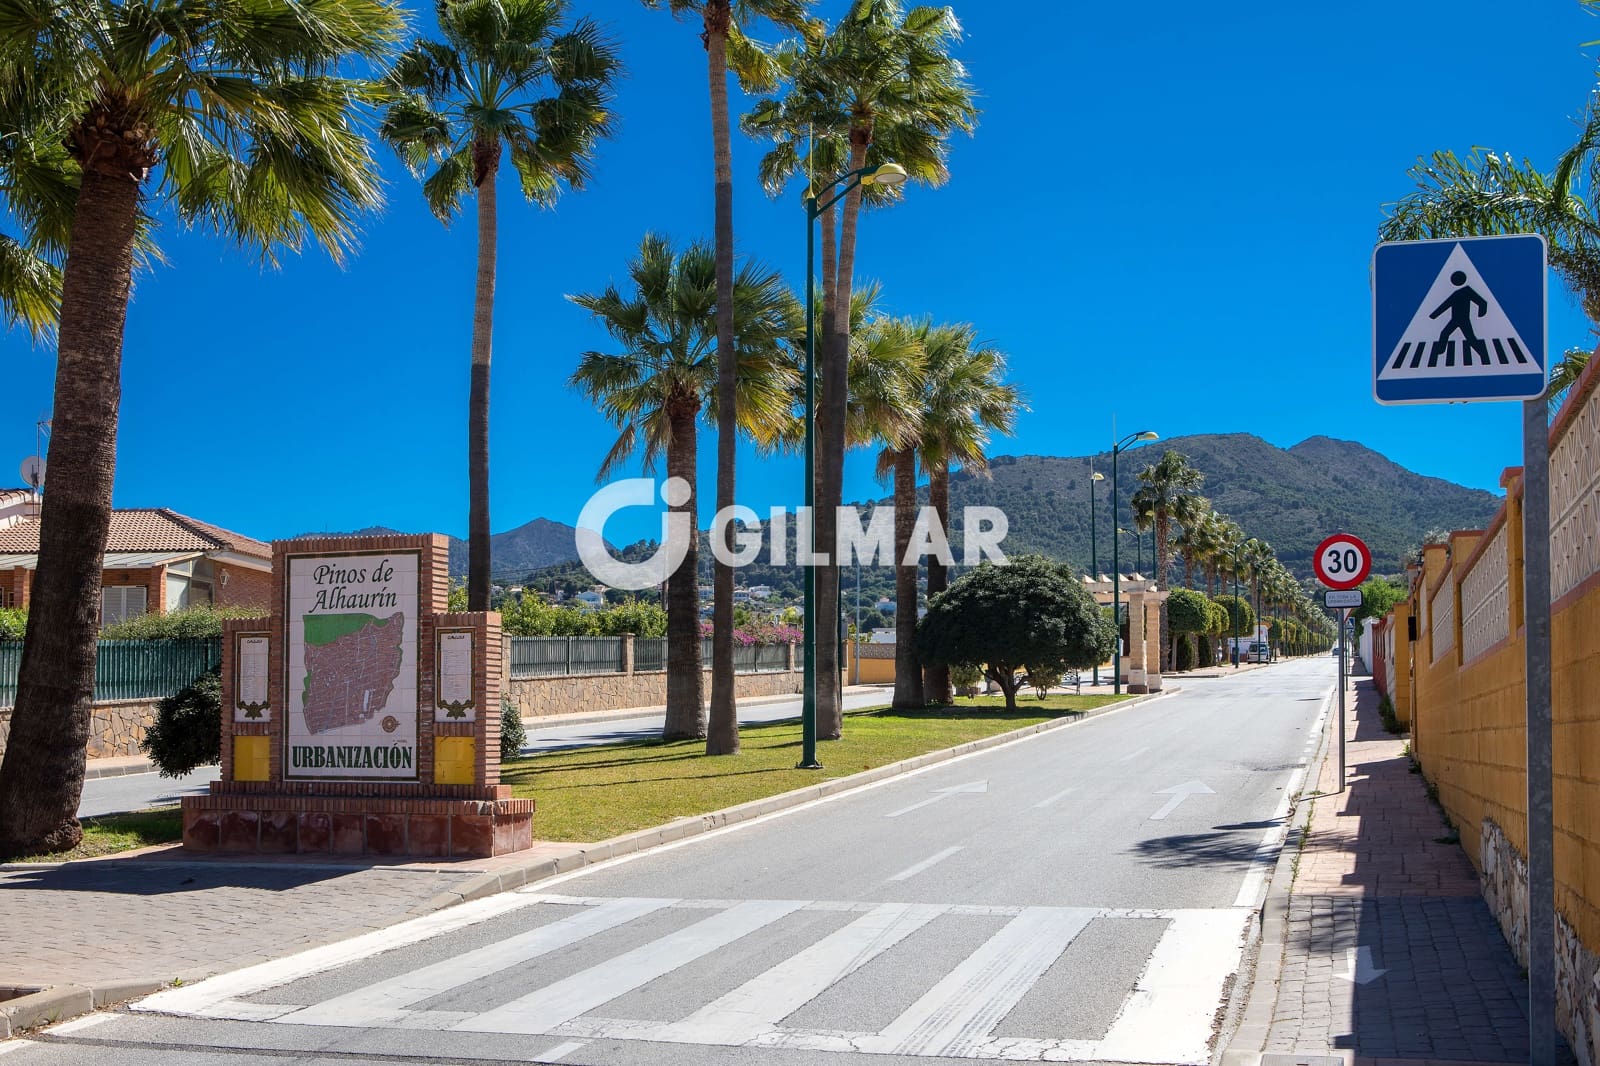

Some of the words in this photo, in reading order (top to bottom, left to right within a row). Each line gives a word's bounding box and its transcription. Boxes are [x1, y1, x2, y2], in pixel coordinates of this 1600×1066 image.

[313, 563, 367, 585] Pinos
[372, 559, 394, 583] de
[1328, 549, 1358, 574] 30
[308, 586, 397, 613] Alhaurín
[292, 742, 413, 769] URBANIZACIÓN
